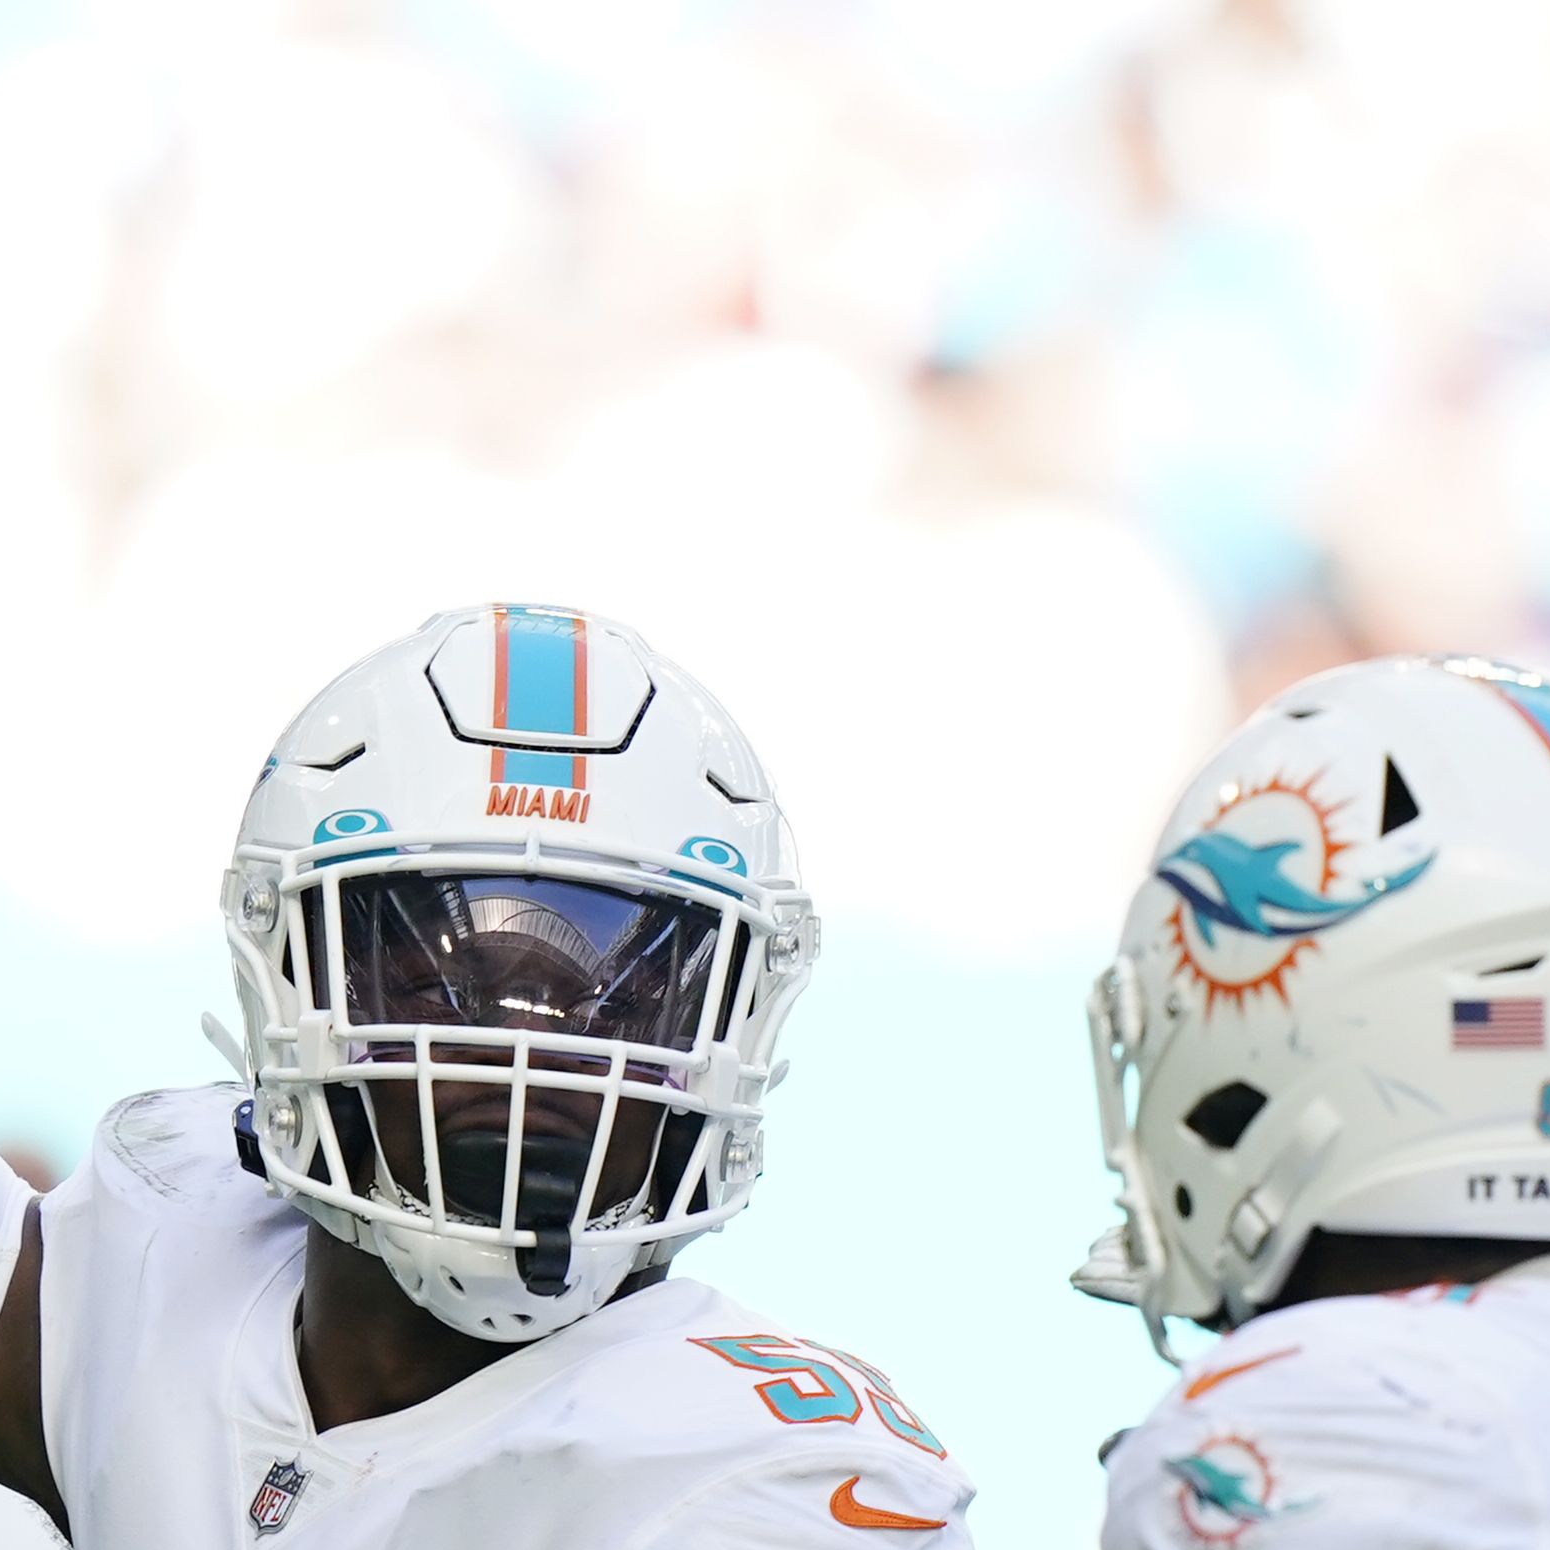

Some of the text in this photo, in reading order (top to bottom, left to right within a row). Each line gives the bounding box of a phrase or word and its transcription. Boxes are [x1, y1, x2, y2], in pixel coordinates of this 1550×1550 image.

[486, 785, 590, 823] MIAMI
[1467, 1174, 1496, 1200] IT
[252, 1486, 287, 1523] NFL
